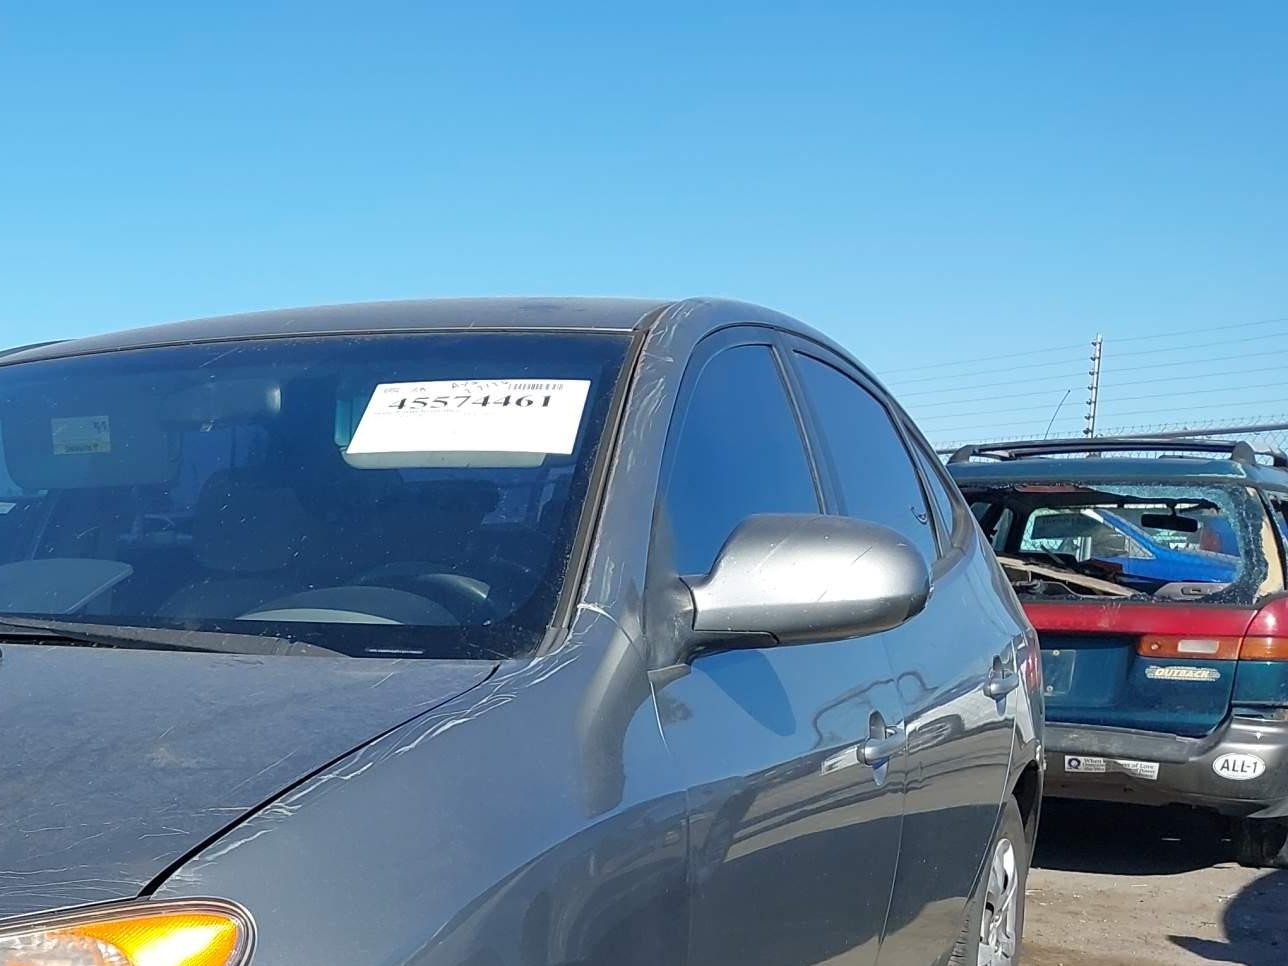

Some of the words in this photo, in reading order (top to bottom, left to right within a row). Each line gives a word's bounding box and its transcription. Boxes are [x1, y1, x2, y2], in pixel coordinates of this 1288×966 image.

[388, 395, 552, 410] 45574461
[1154, 668, 1210, 678] OUTBACK
[1220, 759, 1258, 774] ALL-1
